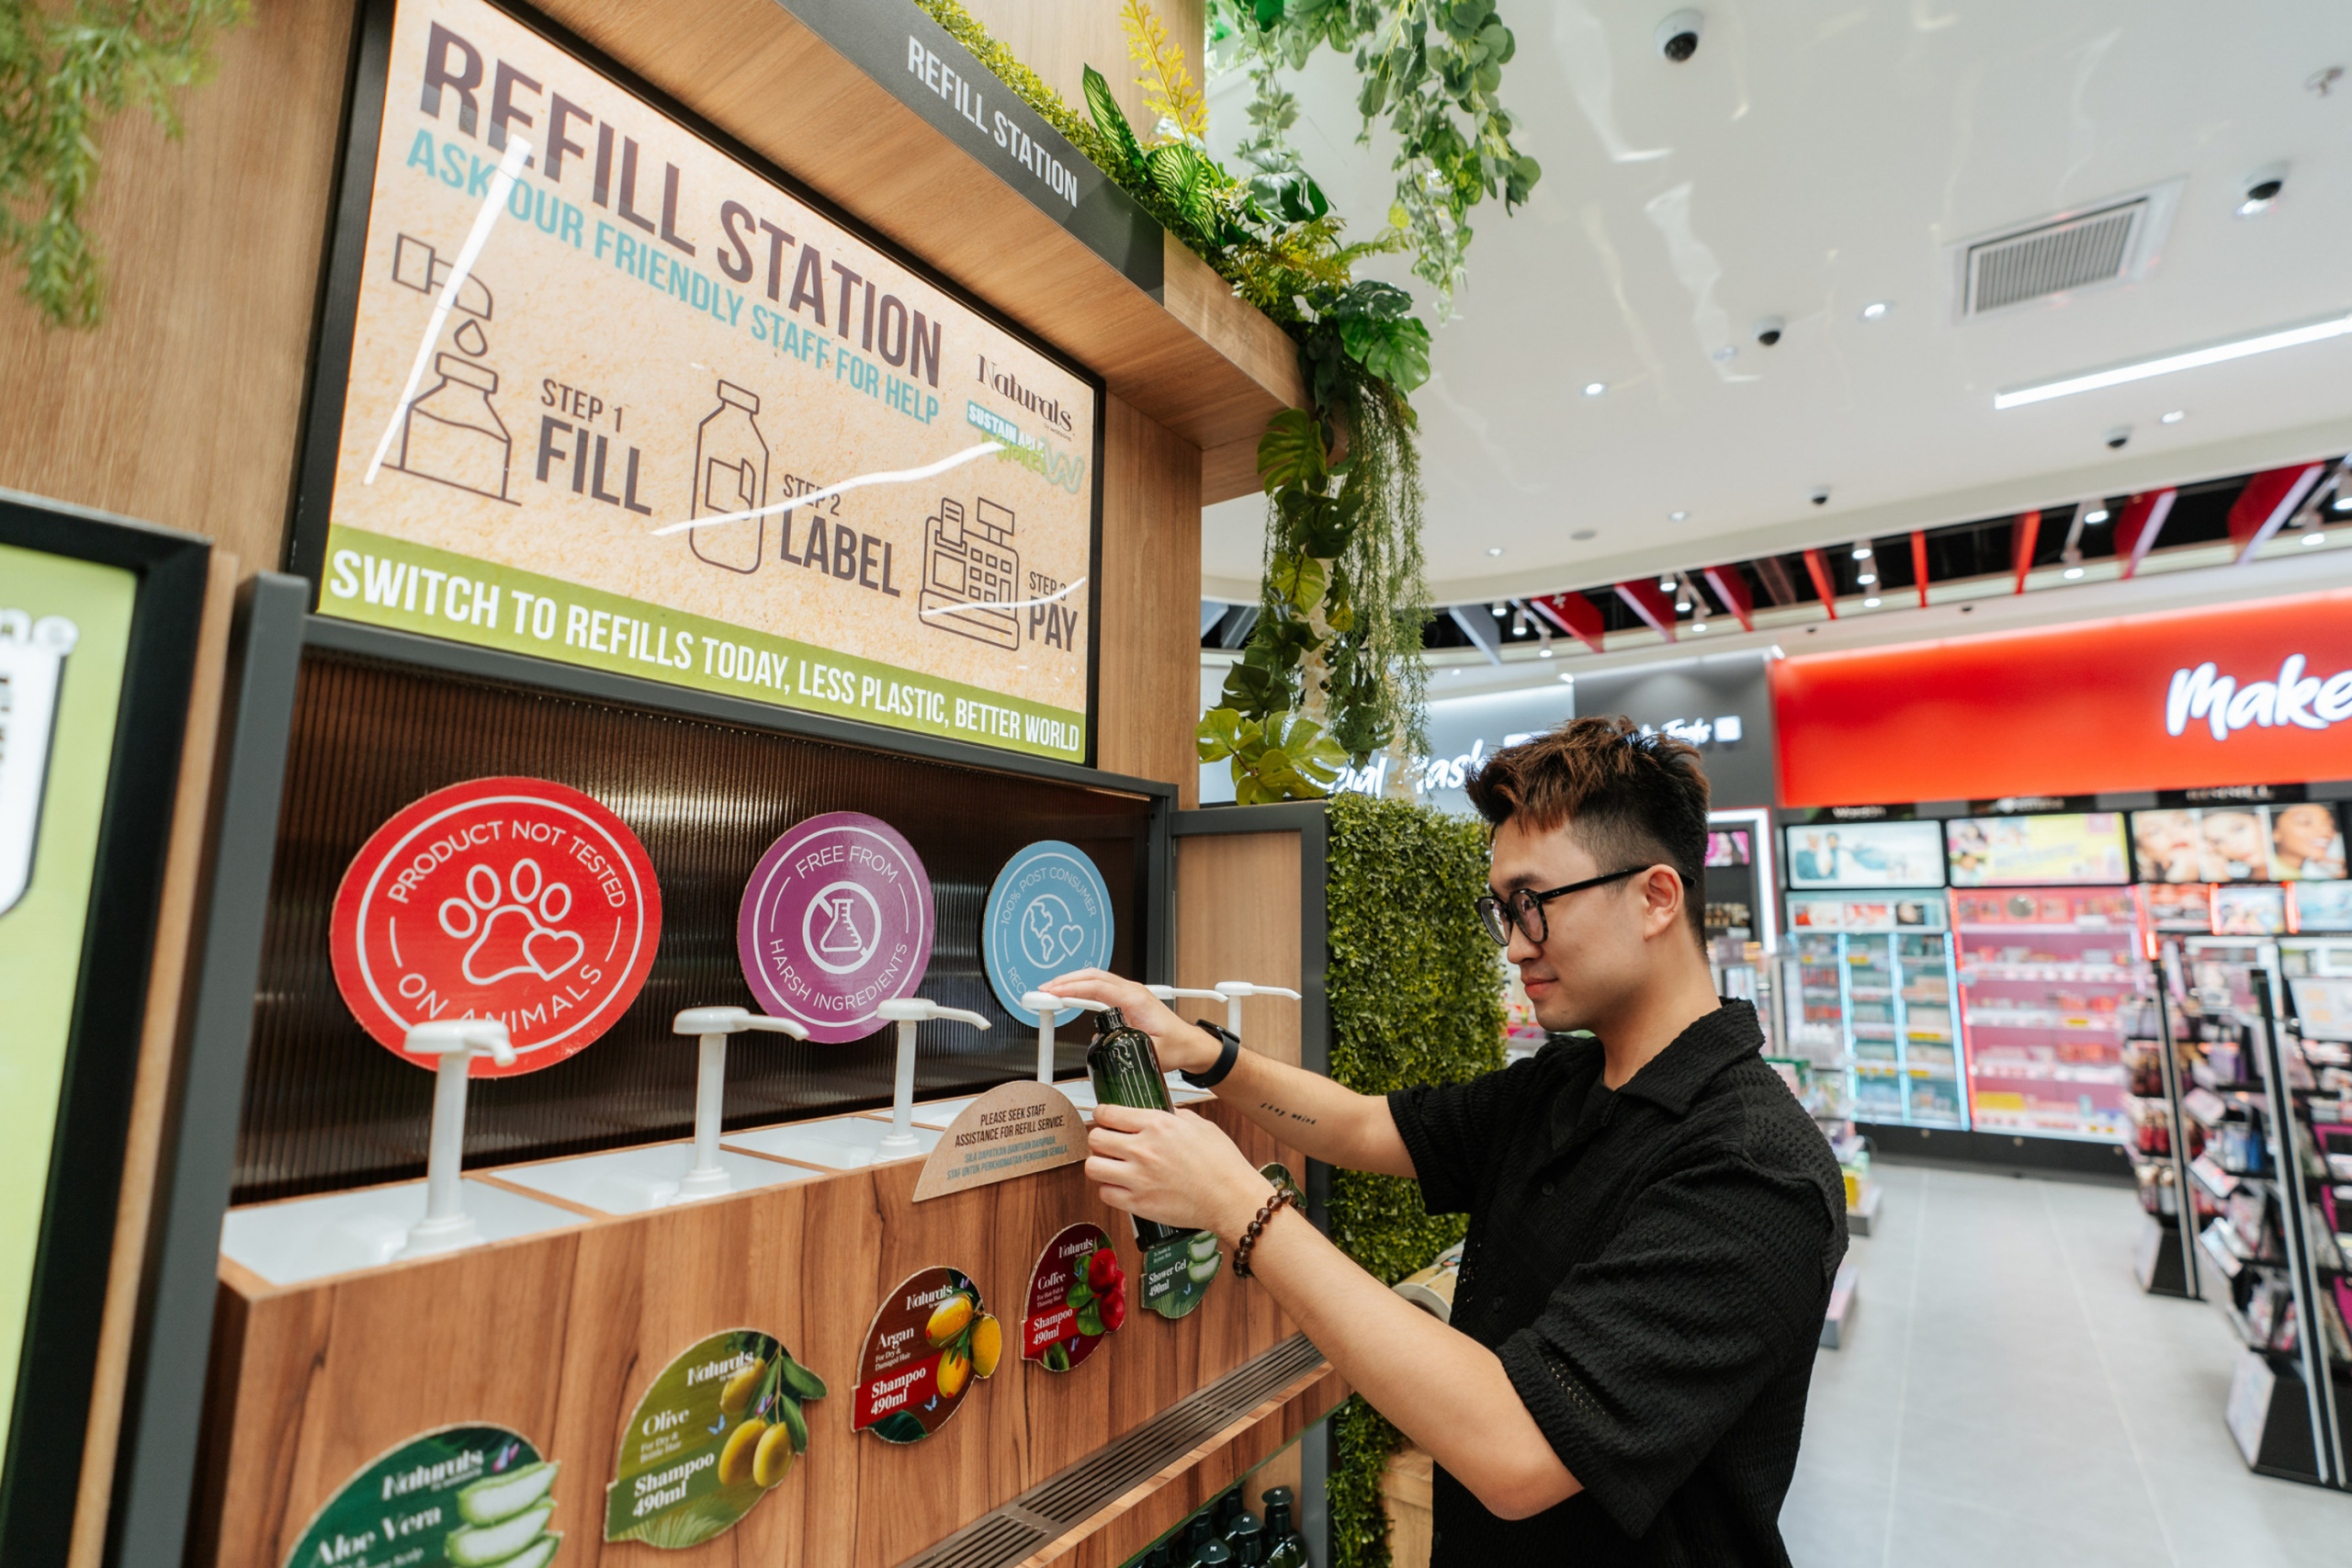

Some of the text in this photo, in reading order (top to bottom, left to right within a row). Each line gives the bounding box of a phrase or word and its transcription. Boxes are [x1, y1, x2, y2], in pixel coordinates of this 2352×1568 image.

[908, 35, 1078, 208] REFILL STATION
[420, 20, 942, 389] REFILL STATION
[405, 129, 939, 425] ASK OUR FRIENDLY STAFF FOR HELP
[541, 378, 623, 434] STEP 1
[977, 354, 1073, 433] Naturals
[536, 414, 652, 516] FILL
[783, 474, 842, 516] STEP 2
[780, 506, 901, 598] LABEL
[1029, 571, 1057, 596] STEP
[1028, 595, 1079, 653] PAY
[330, 549, 1080, 752] SWITCH TO REFILLS TODAY, LESS PLASTIC, BETTER WORLD
[388, 820, 627, 908] PRODUCT NOT TESTED
[796, 845, 899, 883] FREE FROM
[1001, 867, 1097, 925] 100% POST CONSUMER
[770, 939, 908, 1010] HARSH INGREDIENTS
[399, 973, 448, 1020] ON
[955, 1115, 1065, 1147] ASSISTANCE FOR REFILL SERVICE.
[980, 1104, 1046, 1126] PLEASE SEEK STAFF
[965, 1153, 977, 1163] SILA
[978, 1146, 1007, 1160] DAPATKAN
[1008, 1141, 1031, 1155] BANTUAN
[947, 1168, 960, 1180] STAF
[962, 1164, 980, 1177] UNTUK
[1058, 1238, 1093, 1258] Naturals
[1037, 1271, 1066, 1291] Coffee
[1148, 1258, 1187, 1285] Shower Gel
[1148, 1279, 1170, 1297] 490ml
[906, 1284, 953, 1311] Naturals
[1033, 1308, 1073, 1332] Shampoo
[1033, 1325, 1059, 1346] 490ml
[876, 1327, 914, 1350] Argan
[876, 1347, 901, 1363] For Dry &
[687, 1351, 754, 1386] Naturals
[875, 1352, 911, 1371] Damaged Hair
[871, 1367, 927, 1399] Shampoo
[870, 1389, 908, 1416] 490ml
[642, 1409, 690, 1437] Olive
[382, 1450, 484, 1501] Naturals
[634, 1452, 715, 1498] Shampoo
[632, 1480, 687, 1517] 490ml
[319, 1507, 442, 1565] Aloe Vera
